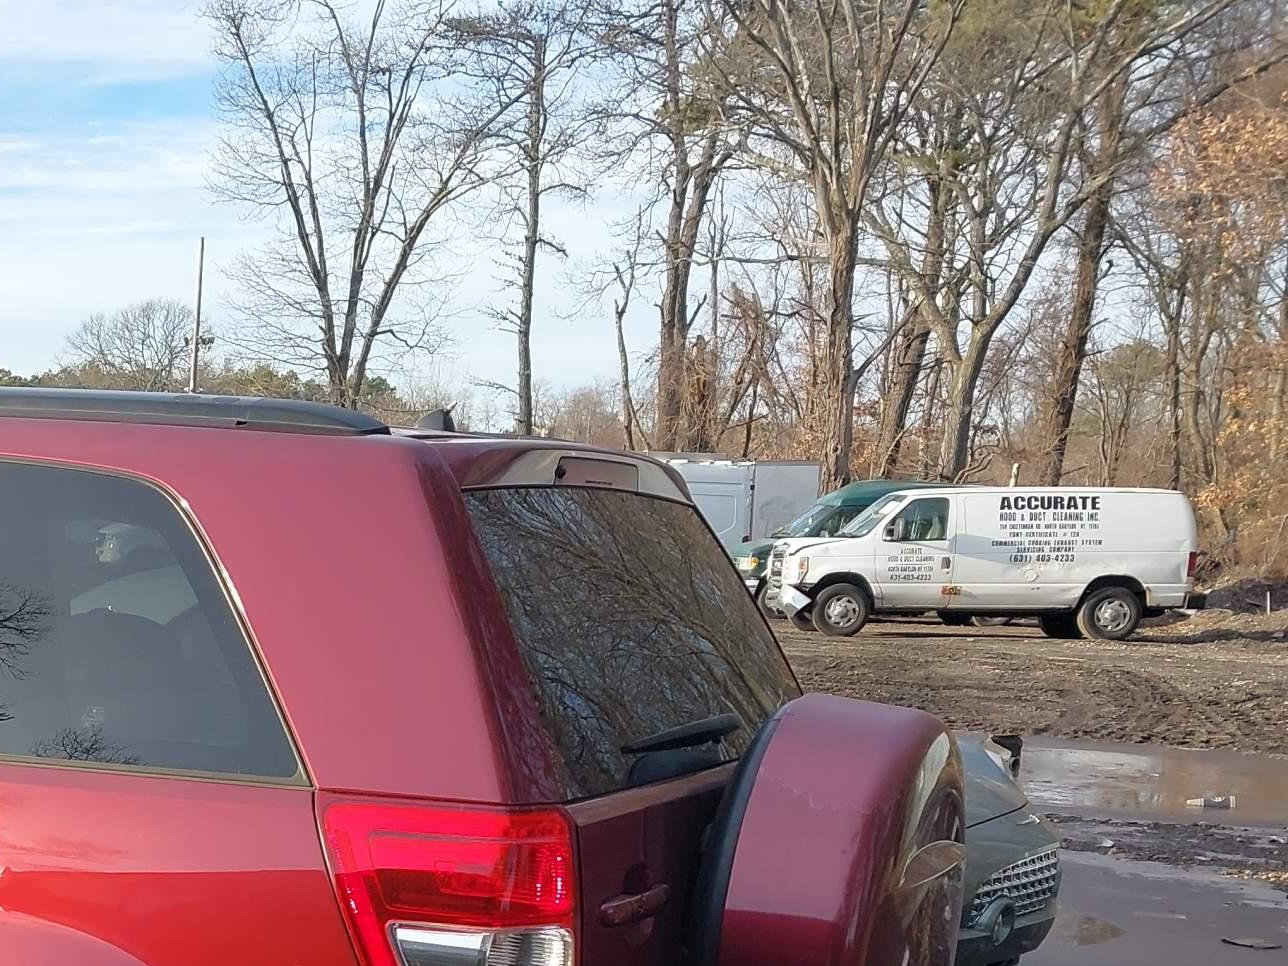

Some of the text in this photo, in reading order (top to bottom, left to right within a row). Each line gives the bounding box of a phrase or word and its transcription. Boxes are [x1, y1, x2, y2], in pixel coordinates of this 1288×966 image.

[999, 496, 1101, 511] ACCURATE
[999, 512, 1017, 522] HOOD
[1020, 513, 1026, 522] &
[1029, 512, 1047, 522] DUCT
[1052, 512, 1084, 522] CLEANING
[1009, 554, 1075, 563] (631) 403-4233
[889, 573, 932, 581] 631-403-4233
